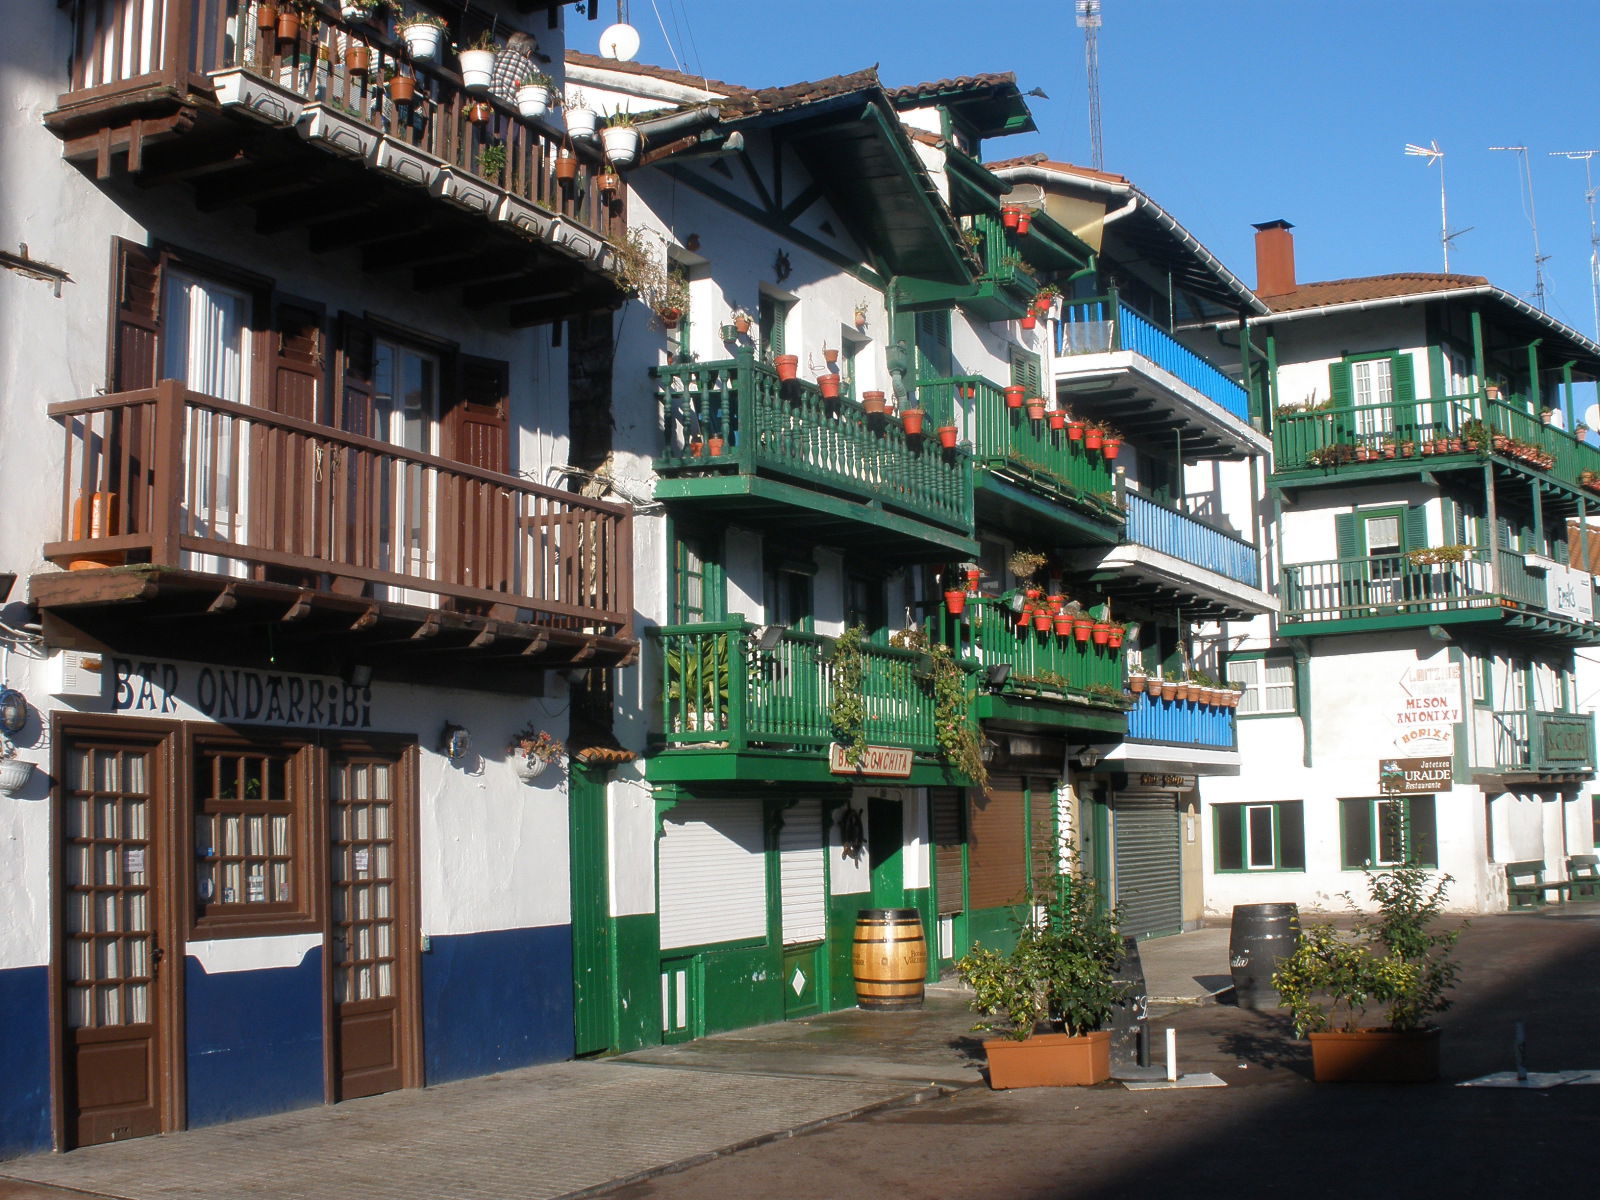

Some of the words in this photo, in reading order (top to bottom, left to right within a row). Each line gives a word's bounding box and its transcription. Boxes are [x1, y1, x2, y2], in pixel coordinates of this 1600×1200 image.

[111, 657, 179, 714] BAR
[1406, 696, 1449, 709] MESON
[864, 751, 907, 771] CONCHITA
[1404, 769, 1451, 781] URALDE
[1405, 781, 1441, 790] Restaurante
